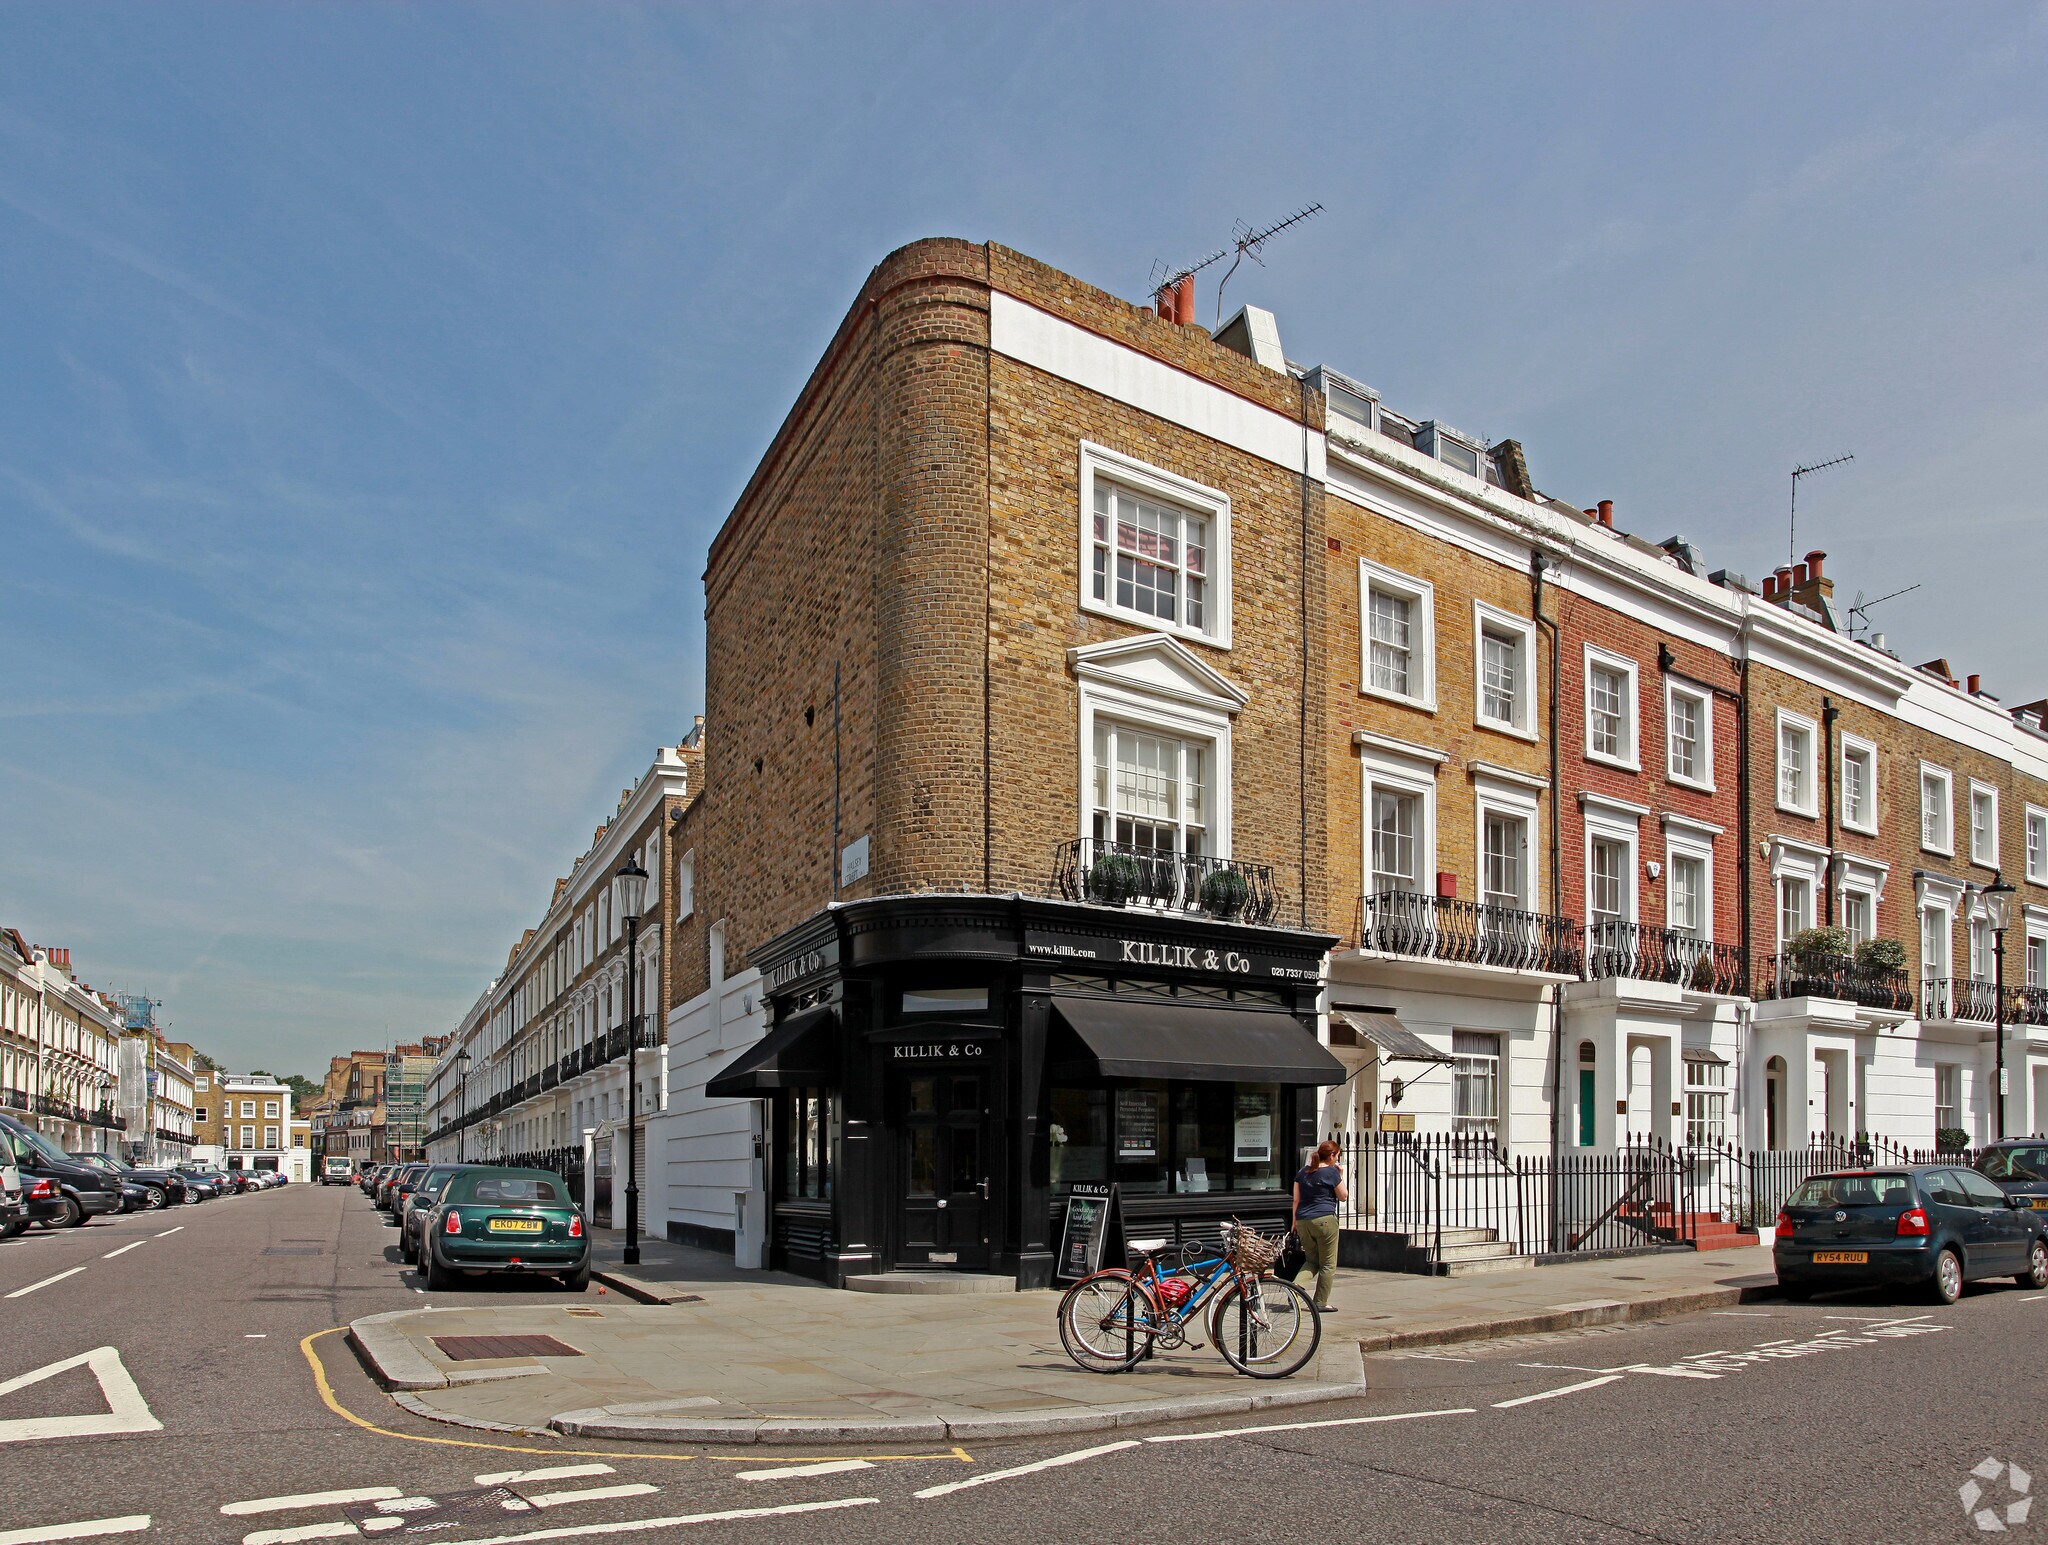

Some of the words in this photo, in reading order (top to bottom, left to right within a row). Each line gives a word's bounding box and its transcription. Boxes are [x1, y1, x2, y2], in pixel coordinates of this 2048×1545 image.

[1029, 944, 1096, 958] www.killik.com
[1119, 940, 1197, 968] KILLIK
[1202, 949, 1219, 971] &
[1225, 951, 1250, 973] Co
[1271, 967, 1284, 976] 020
[1286, 968, 1302, 978] 7337
[772, 958, 797, 988] KILLIK
[800, 955, 806, 976] &
[808, 951, 819, 971] Co
[893, 1045, 944, 1058] KILLIK
[948, 1044, 959, 1056] &
[964, 1043, 982, 1056] Co
[752, 1134, 762, 1142] 45
[1072, 1184, 1093, 1194] KILLIK
[1093, 1186, 1099, 1194] &
[1099, 1185, 1109, 1194] Co
[2036, 1200, 2048, 1208] TR
[494, 1219, 518, 1228] EK07
[1816, 1252, 1841, 1262] RY54
[1843, 1252, 1864, 1262] RUU
